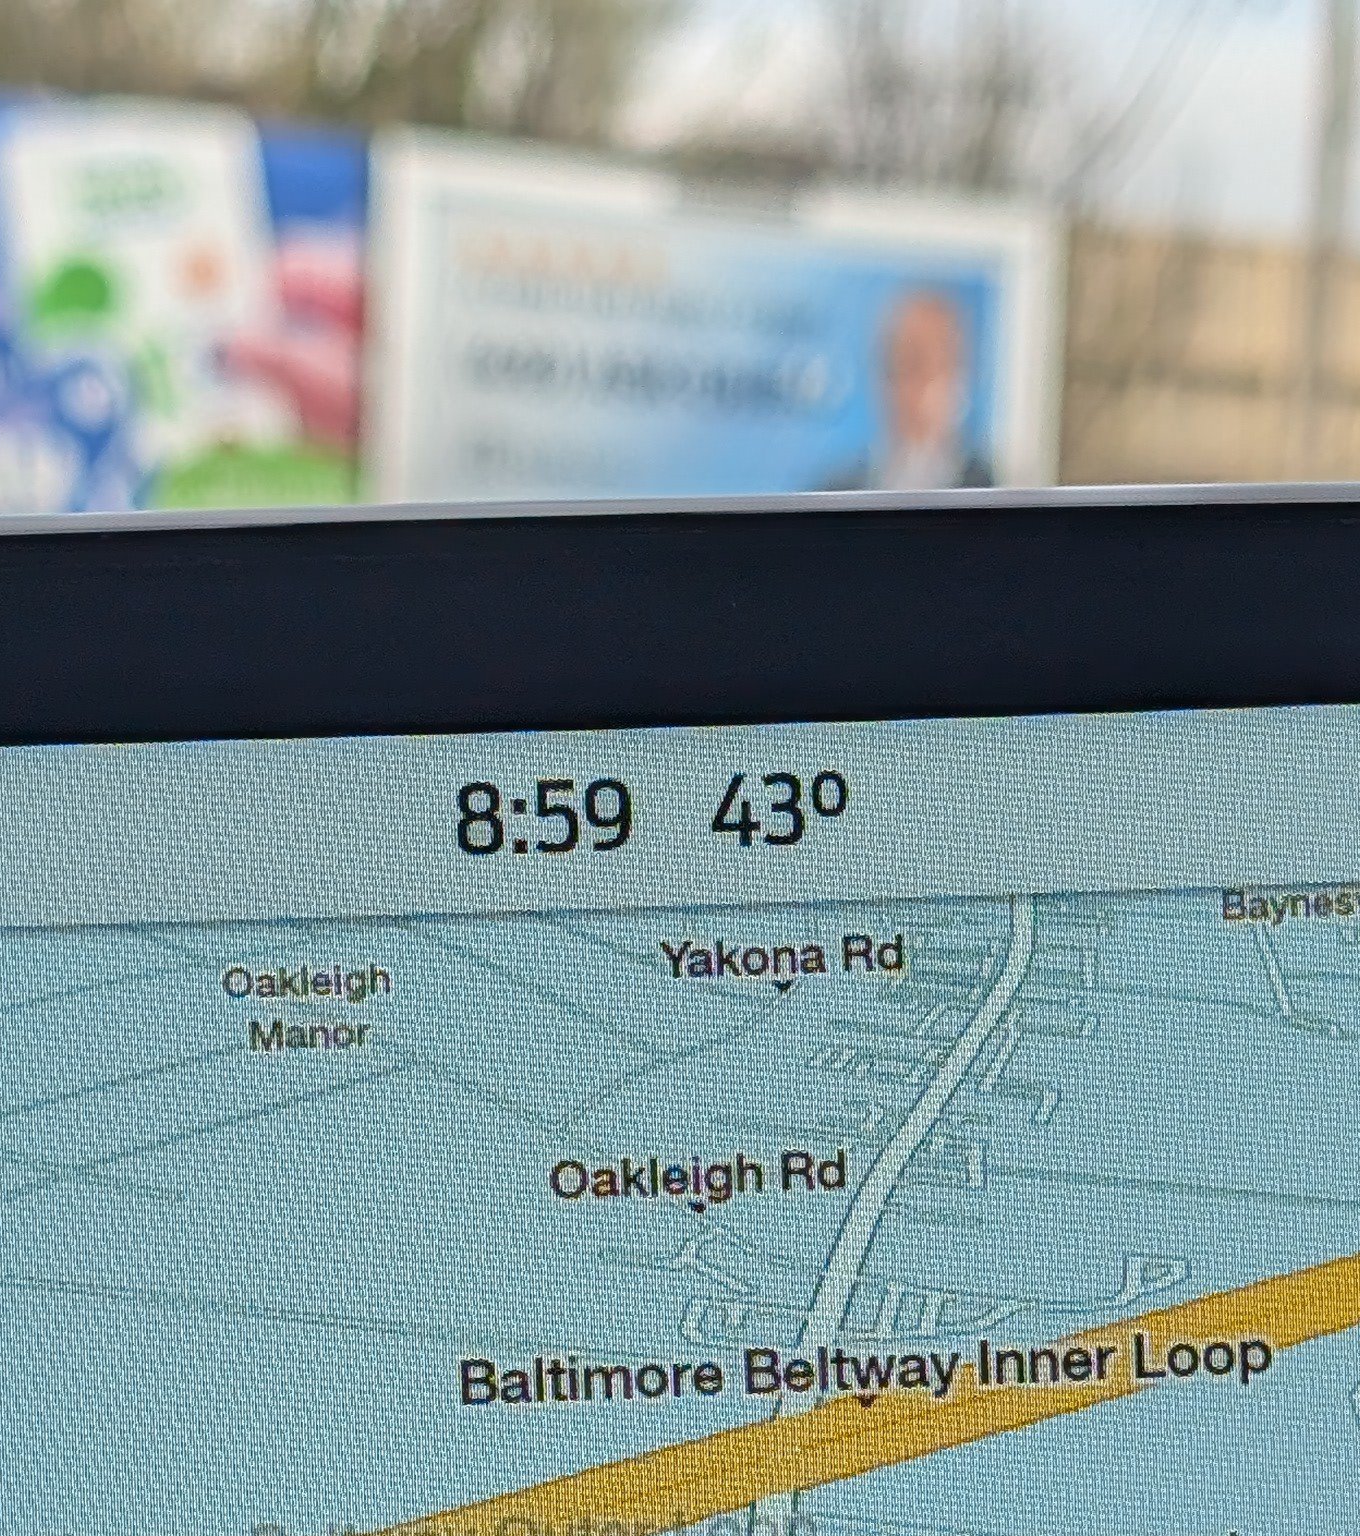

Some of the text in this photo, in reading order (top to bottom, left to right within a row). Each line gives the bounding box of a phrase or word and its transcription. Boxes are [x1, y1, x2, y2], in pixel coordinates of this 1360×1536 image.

[455, 778, 633, 856] 8:59
[660, 933, 905, 978] Yakona Rd
[221, 963, 392, 1004] Oakleigh
[248, 1019, 370, 1052] Manor
[550, 1149, 846, 1203] Oakleigh Rd
[459, 1332, 1273, 1406] Baltimore Beltway Inner Loop
